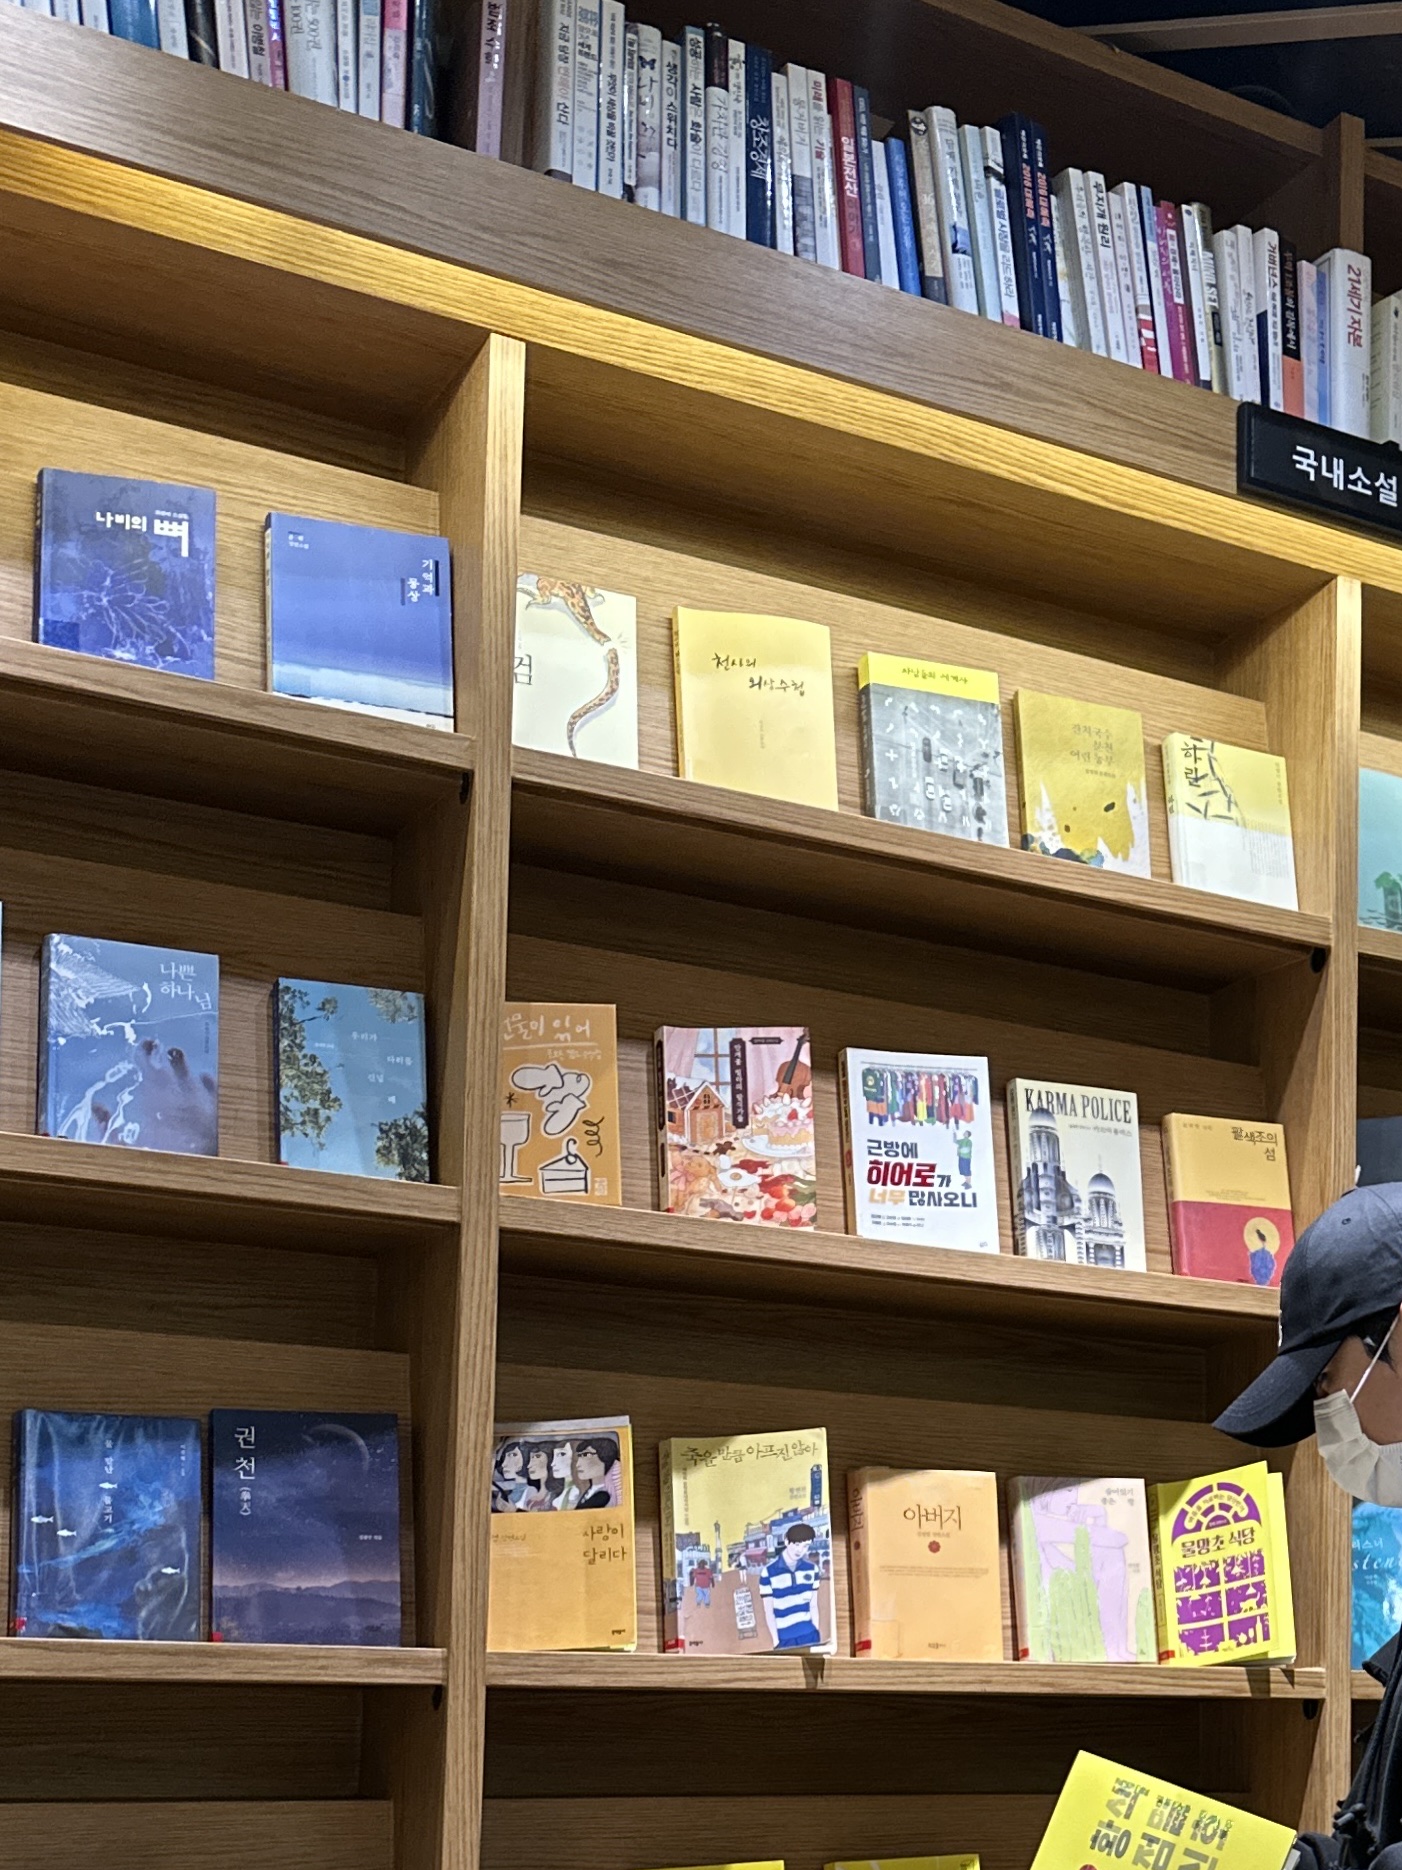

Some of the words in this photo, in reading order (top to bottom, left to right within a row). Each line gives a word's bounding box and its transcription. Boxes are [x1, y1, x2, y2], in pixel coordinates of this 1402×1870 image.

[749, 114, 770, 182] 창조경제
[1092, 181, 1109, 220] 무지개
[1096, 221, 1111, 249] 원리
[1346, 264, 1363, 315] 21세기
[1347, 316, 1363, 348] 자본
[1291, 444, 1399, 508] 국내소설
[96, 511, 147, 532] 나비의
[406, 577, 421, 603] 몽상
[422, 558, 435, 596] 기억과
[160, 960, 198, 980] 나쁜
[160, 981, 213, 1011] 하나님
[1025, 1087, 1079, 1123] KARMA
[1080, 1092, 1132, 1125] POLICE
[866, 1138, 919, 1160] 근방에
[1231, 1125, 1278, 1147] 팔색조의
[1263, 1146, 1276, 1163] 섬
[866, 1159, 952, 1188] 히어로가
[868, 1188, 906, 1206] 너무
[908, 1189, 979, 1209] 많사오니
[903, 1503, 962, 1531] 아버지
[582, 1522, 626, 1543] 사랑이
[1180, 1537, 1226, 1559] 물망초
[1228, 1526, 1256, 1548] 식당
[582, 1546, 628, 1567] 달리다
